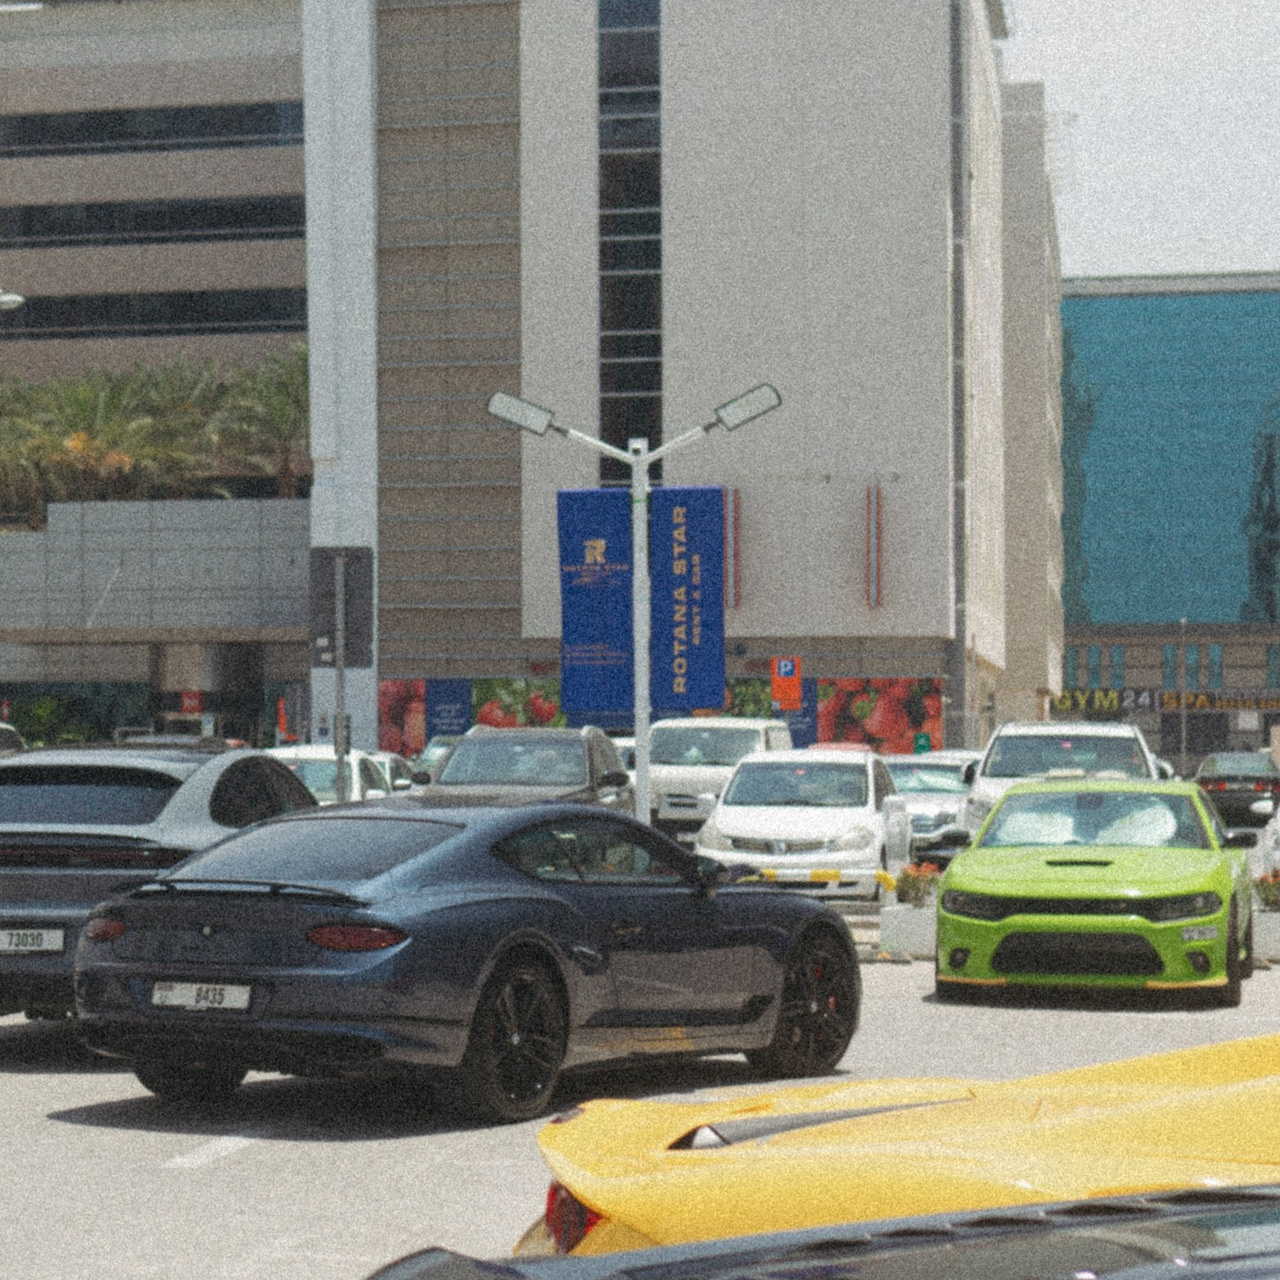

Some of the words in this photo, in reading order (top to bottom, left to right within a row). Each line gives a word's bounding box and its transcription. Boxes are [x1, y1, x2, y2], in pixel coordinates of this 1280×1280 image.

[672, 505, 687, 576] STAR
[672, 586, 688, 694] ROTANA
[1054, 689, 1119, 711] GYM
[1122, 689, 1151, 709] 24
[1162, 691, 1210, 710] SPA
